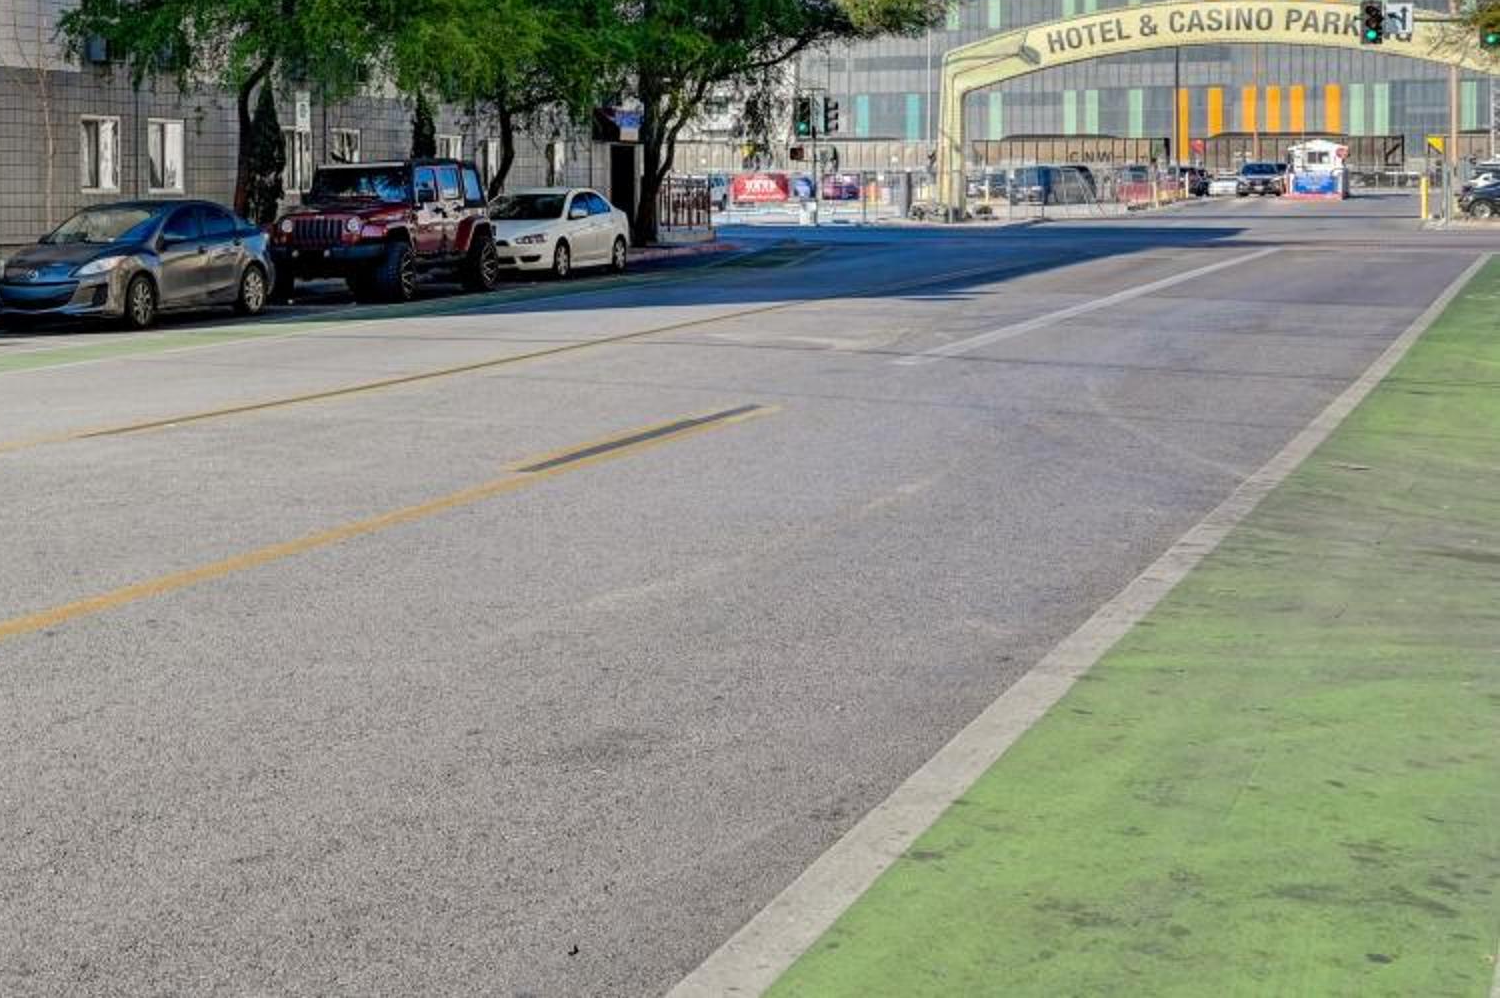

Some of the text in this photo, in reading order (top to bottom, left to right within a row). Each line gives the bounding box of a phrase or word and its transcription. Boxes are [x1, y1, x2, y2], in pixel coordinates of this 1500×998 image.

[1046, 7, 1412, 53] HOTEL & CASINO PARK
